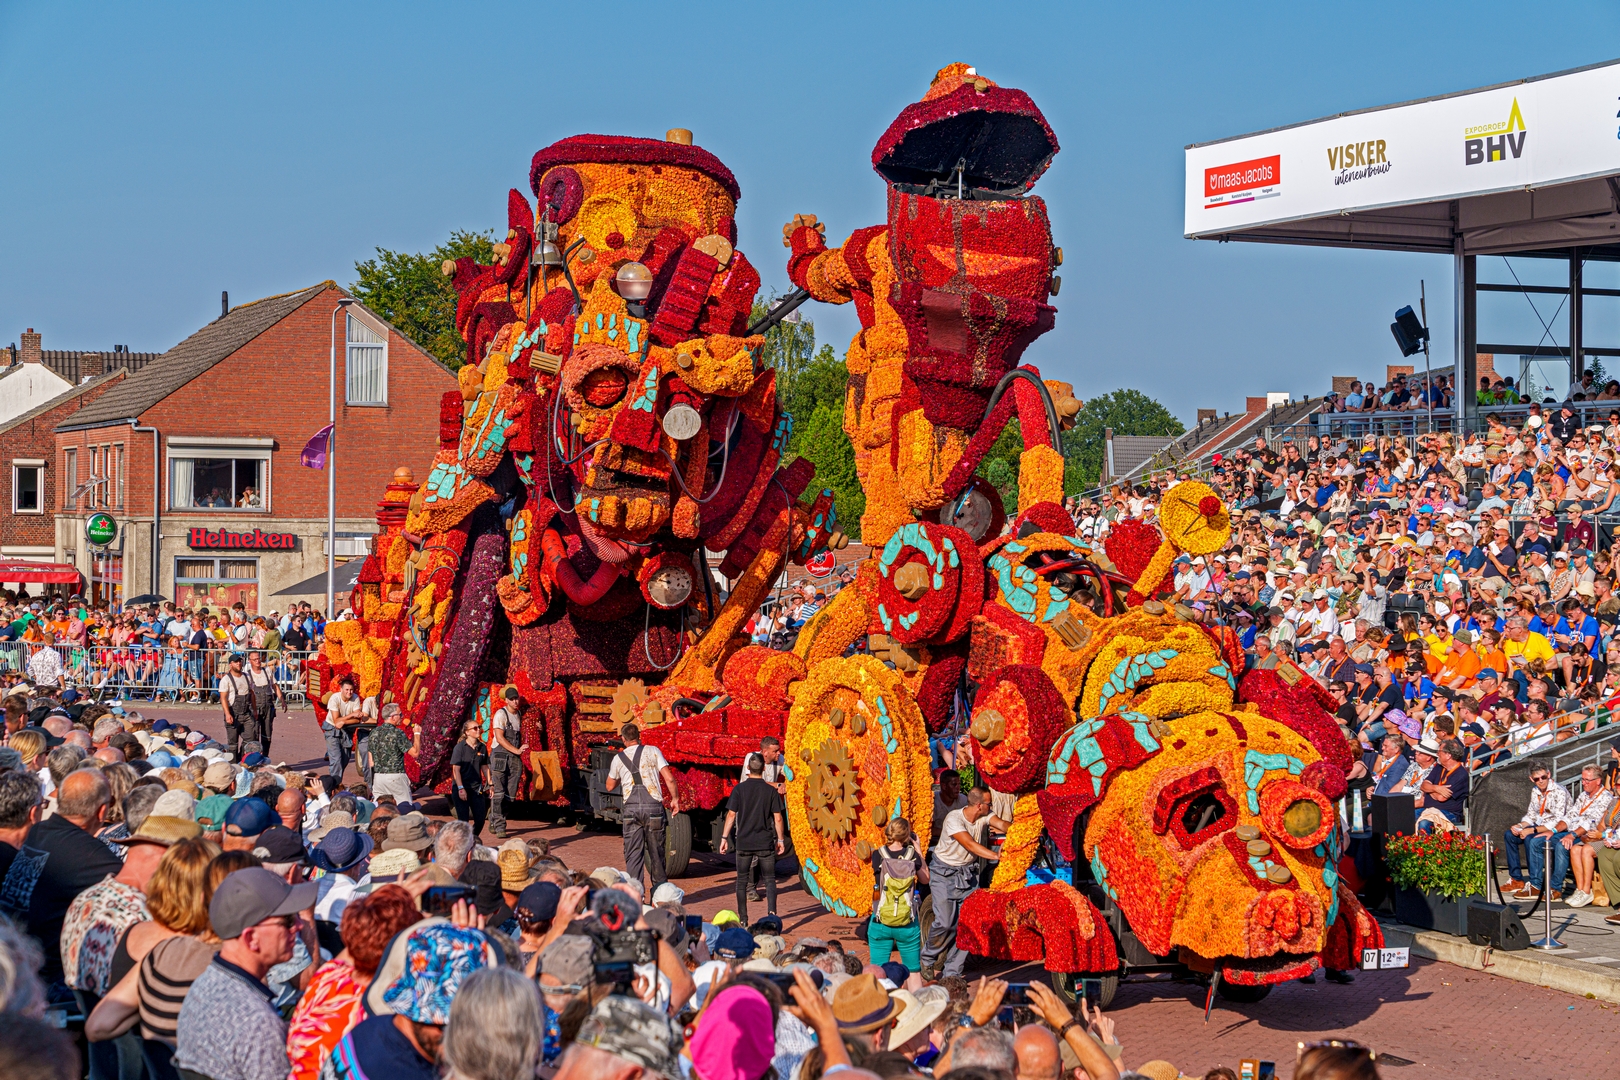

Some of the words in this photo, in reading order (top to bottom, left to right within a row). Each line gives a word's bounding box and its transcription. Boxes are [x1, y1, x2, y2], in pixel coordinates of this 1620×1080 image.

[1465, 121, 1506, 135] EXPOGROEP
[1327, 139, 1387, 171] VISKER
[1465, 131, 1527, 166] BHV
[189, 527, 295, 549] Heineken
[1365, 952, 1376, 962] 07
